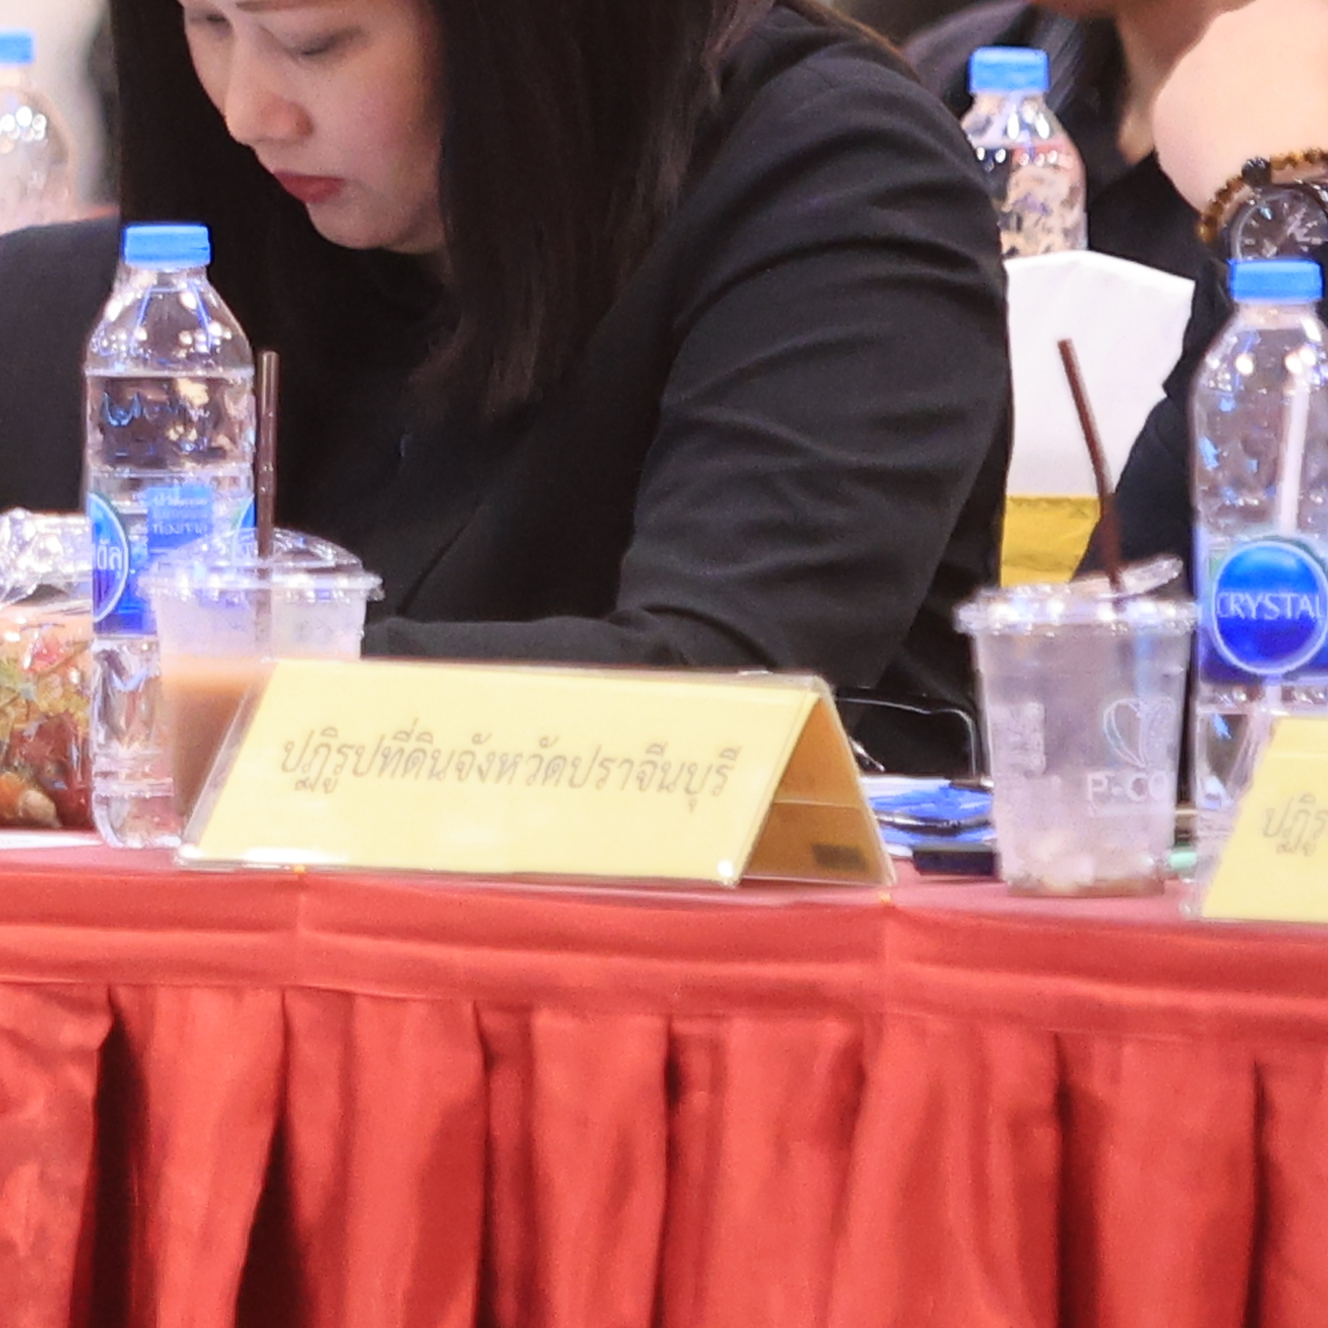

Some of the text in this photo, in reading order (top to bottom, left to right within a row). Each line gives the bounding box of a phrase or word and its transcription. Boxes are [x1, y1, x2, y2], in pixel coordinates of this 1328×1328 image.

[1216, 591, 1326, 621] CRYSTAL
[280, 717, 744, 814] ปฏิรูปที่ดินจังหวัดปราจีนบุรี
